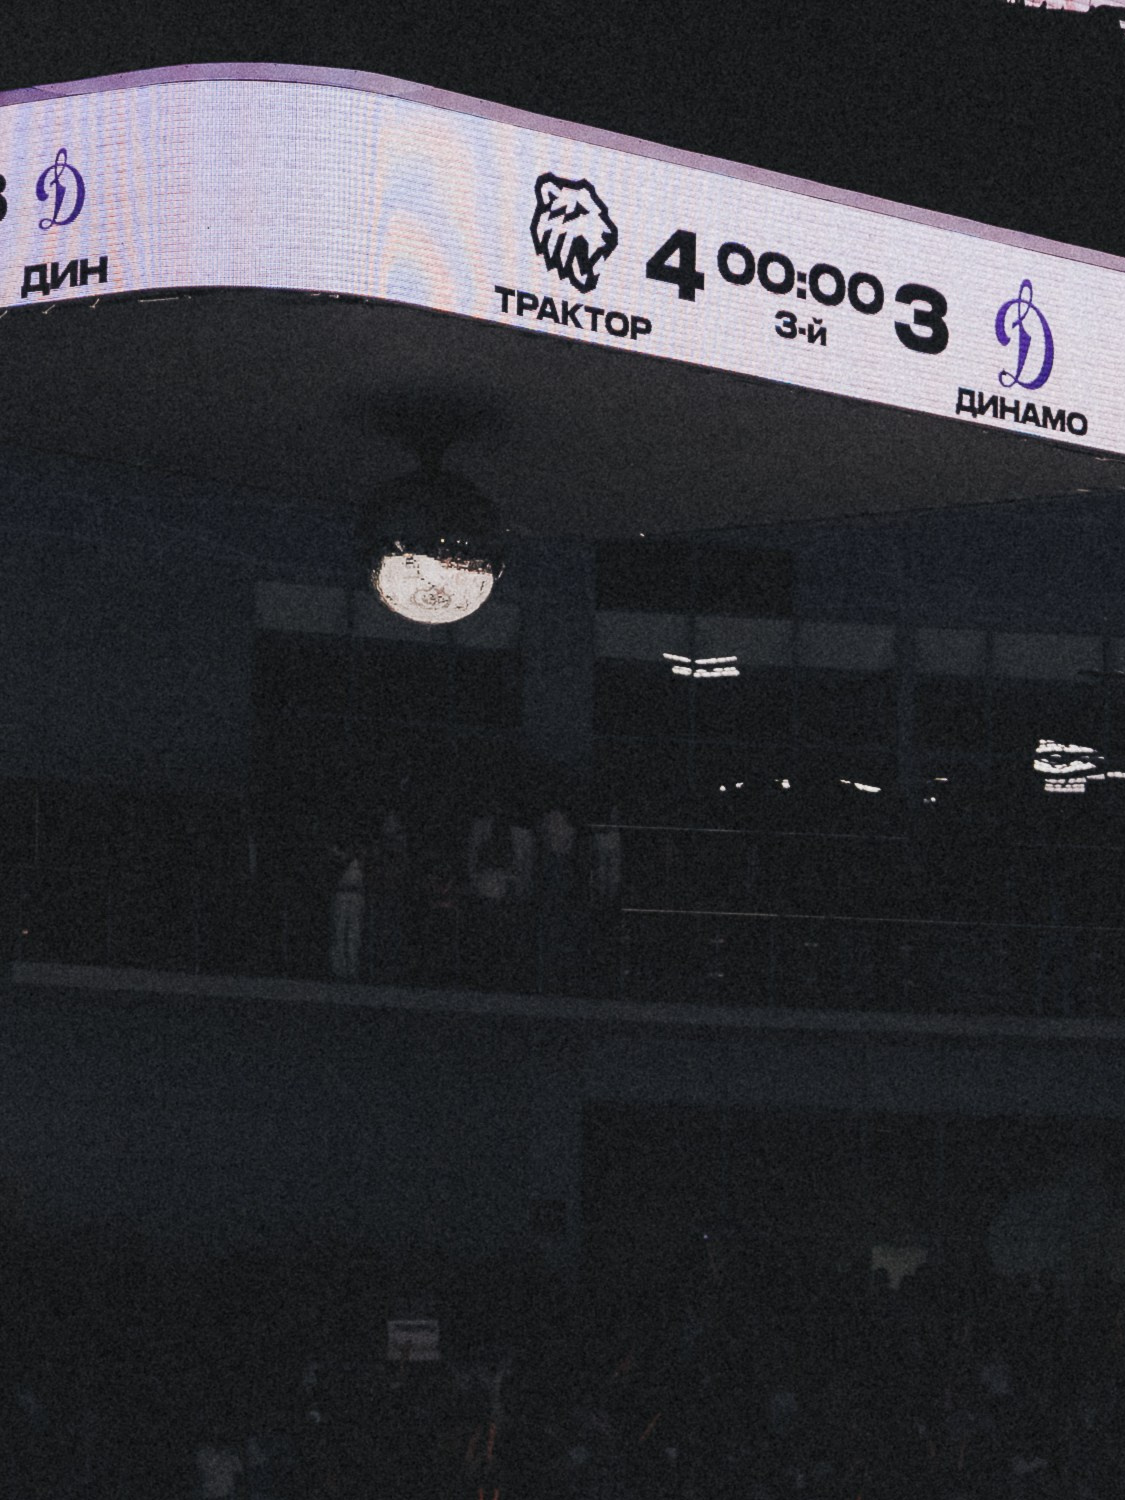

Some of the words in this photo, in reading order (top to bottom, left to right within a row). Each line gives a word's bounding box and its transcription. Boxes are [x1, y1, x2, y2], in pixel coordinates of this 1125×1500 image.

[20, 255, 108, 298] ДИН
[645, 229, 705, 302] 4
[717, 241, 885, 315] 00:00
[894, 282, 949, 355] 3
[494, 285, 653, 340] ТРАКТОР
[774, 309, 827, 347] 3-й
[955, 386, 1088, 437] ДИНАМО
